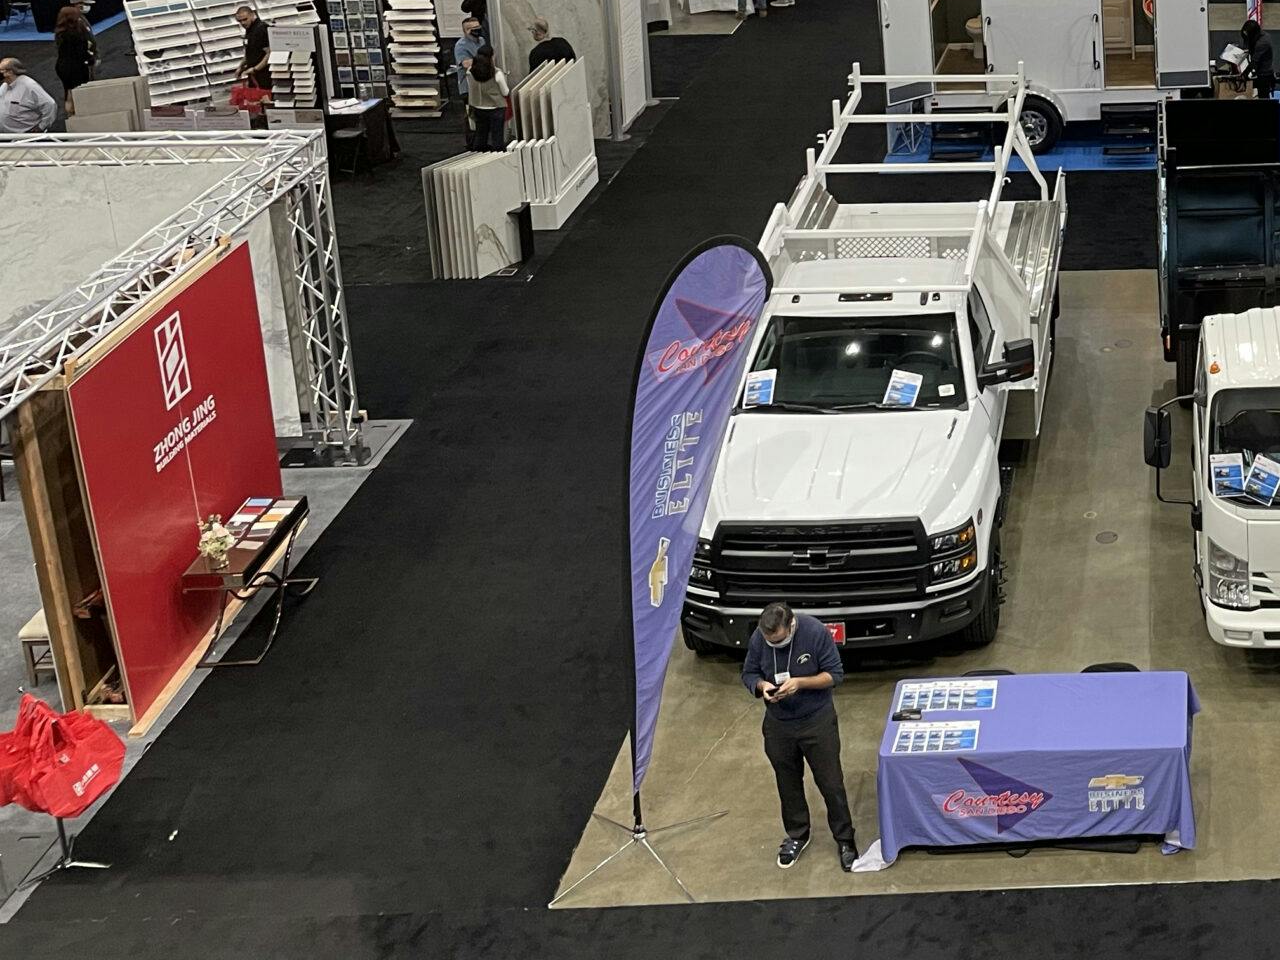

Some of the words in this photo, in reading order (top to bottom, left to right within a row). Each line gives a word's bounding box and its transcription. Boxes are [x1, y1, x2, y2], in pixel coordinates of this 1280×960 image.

[153, 416, 192, 464] ZHONG
[192, 394, 217, 427] JING
[156, 440, 185, 473] BUILDING
[184, 410, 217, 445] MATERIALS
[668, 408, 703, 516] ELITE
[943, 789, 1044, 813] Courtesy
[959, 808, 984, 817] SAN
[987, 805, 1027, 816] DIEGO
